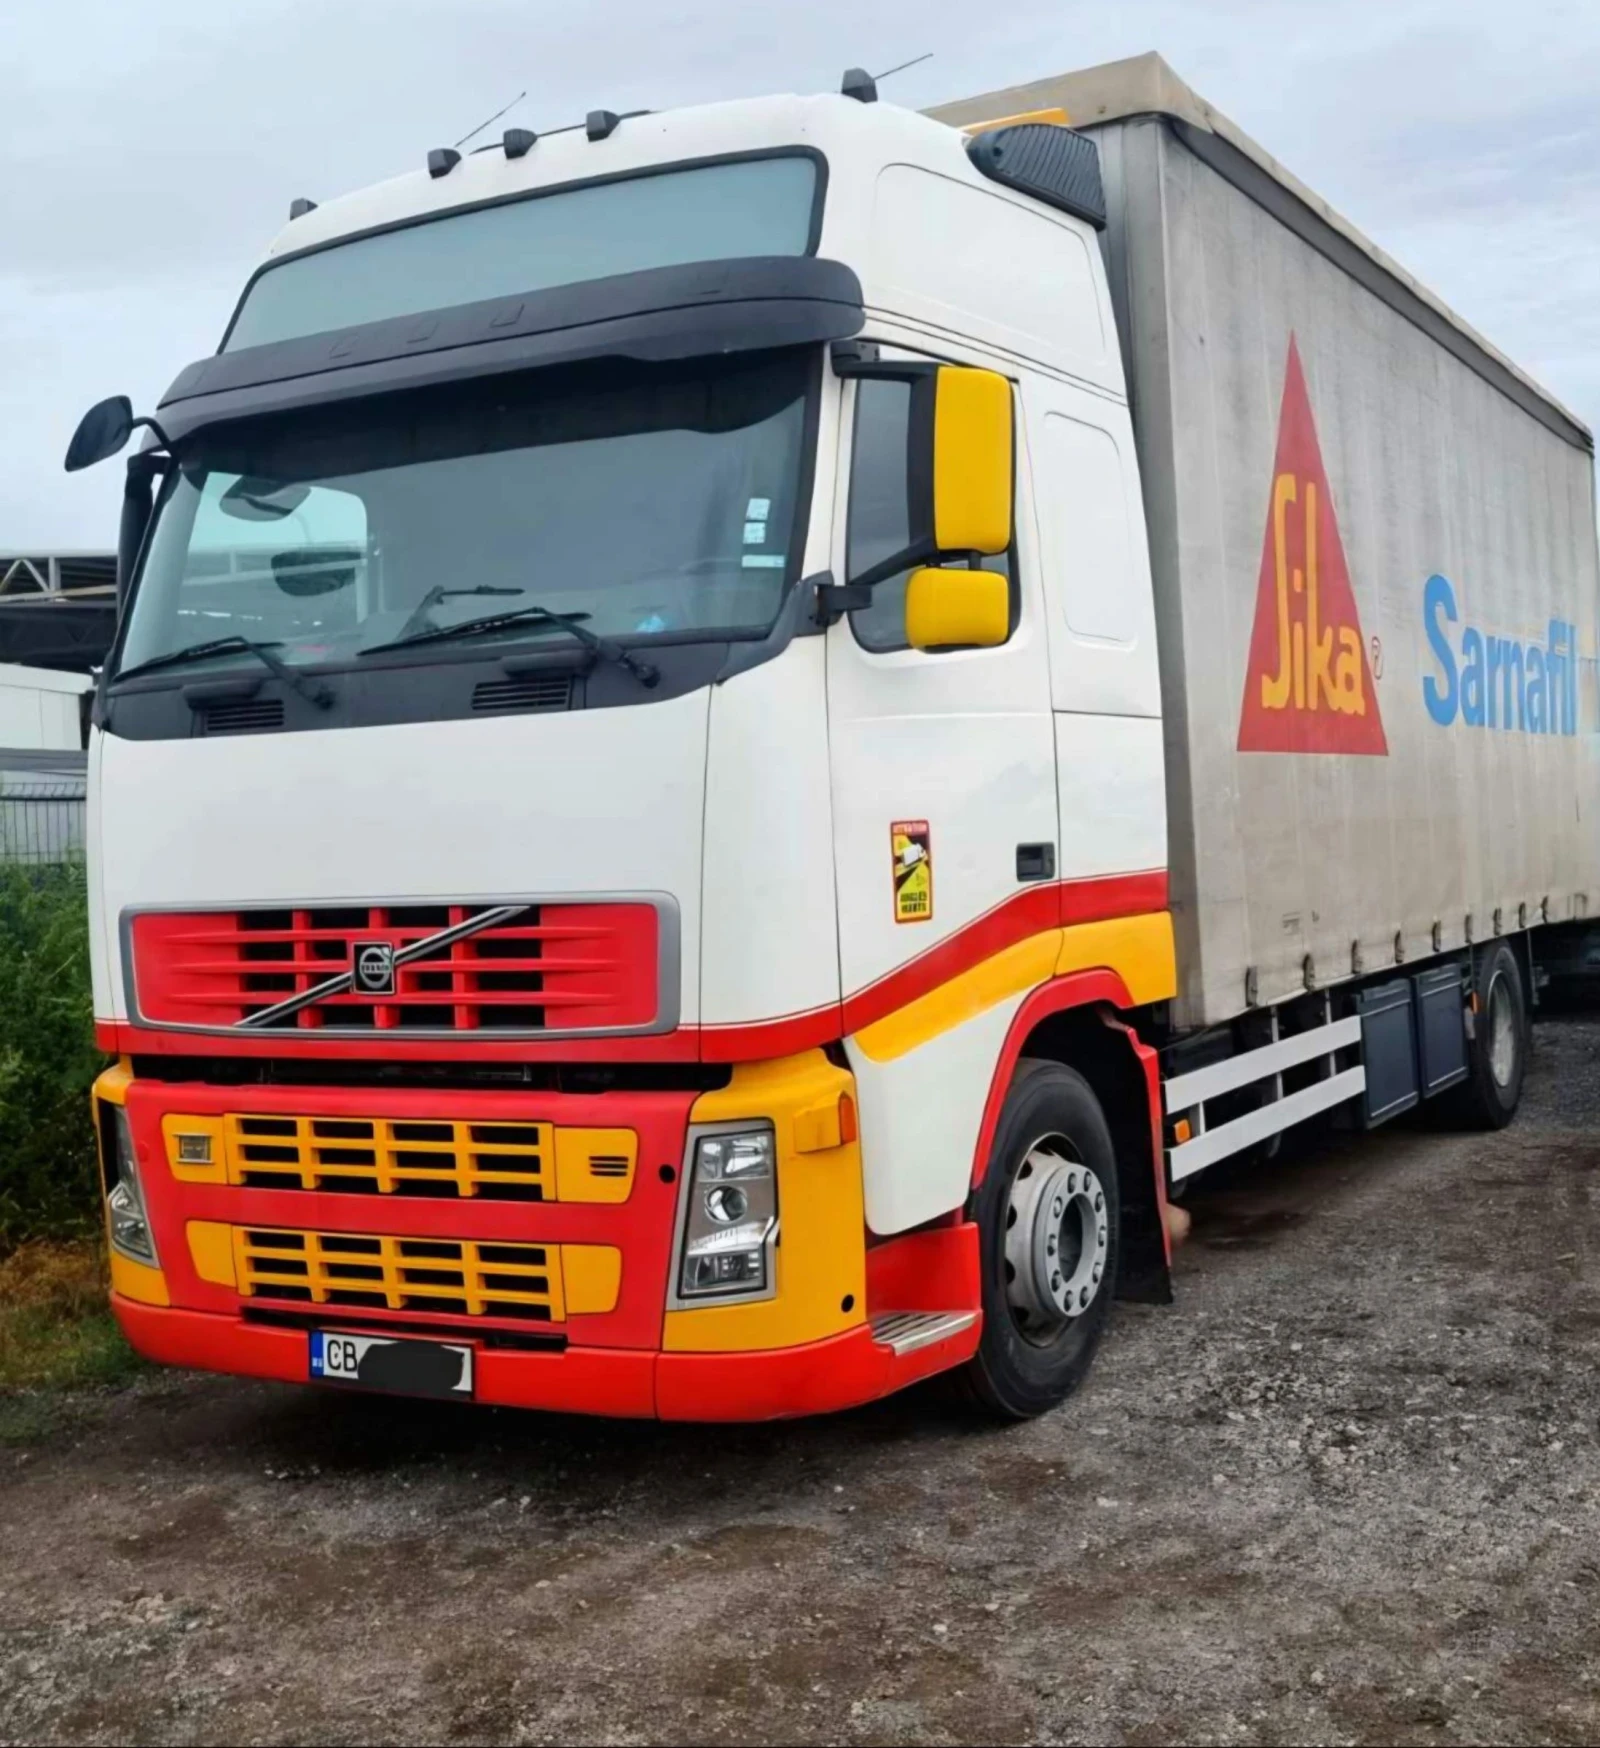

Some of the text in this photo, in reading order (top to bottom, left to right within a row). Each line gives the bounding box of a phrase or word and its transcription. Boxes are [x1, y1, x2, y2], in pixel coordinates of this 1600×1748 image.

[1262, 474, 1365, 716] Sika
[1423, 574, 1577, 736] Sarnafil
[327, 1339, 358, 1372] CB
